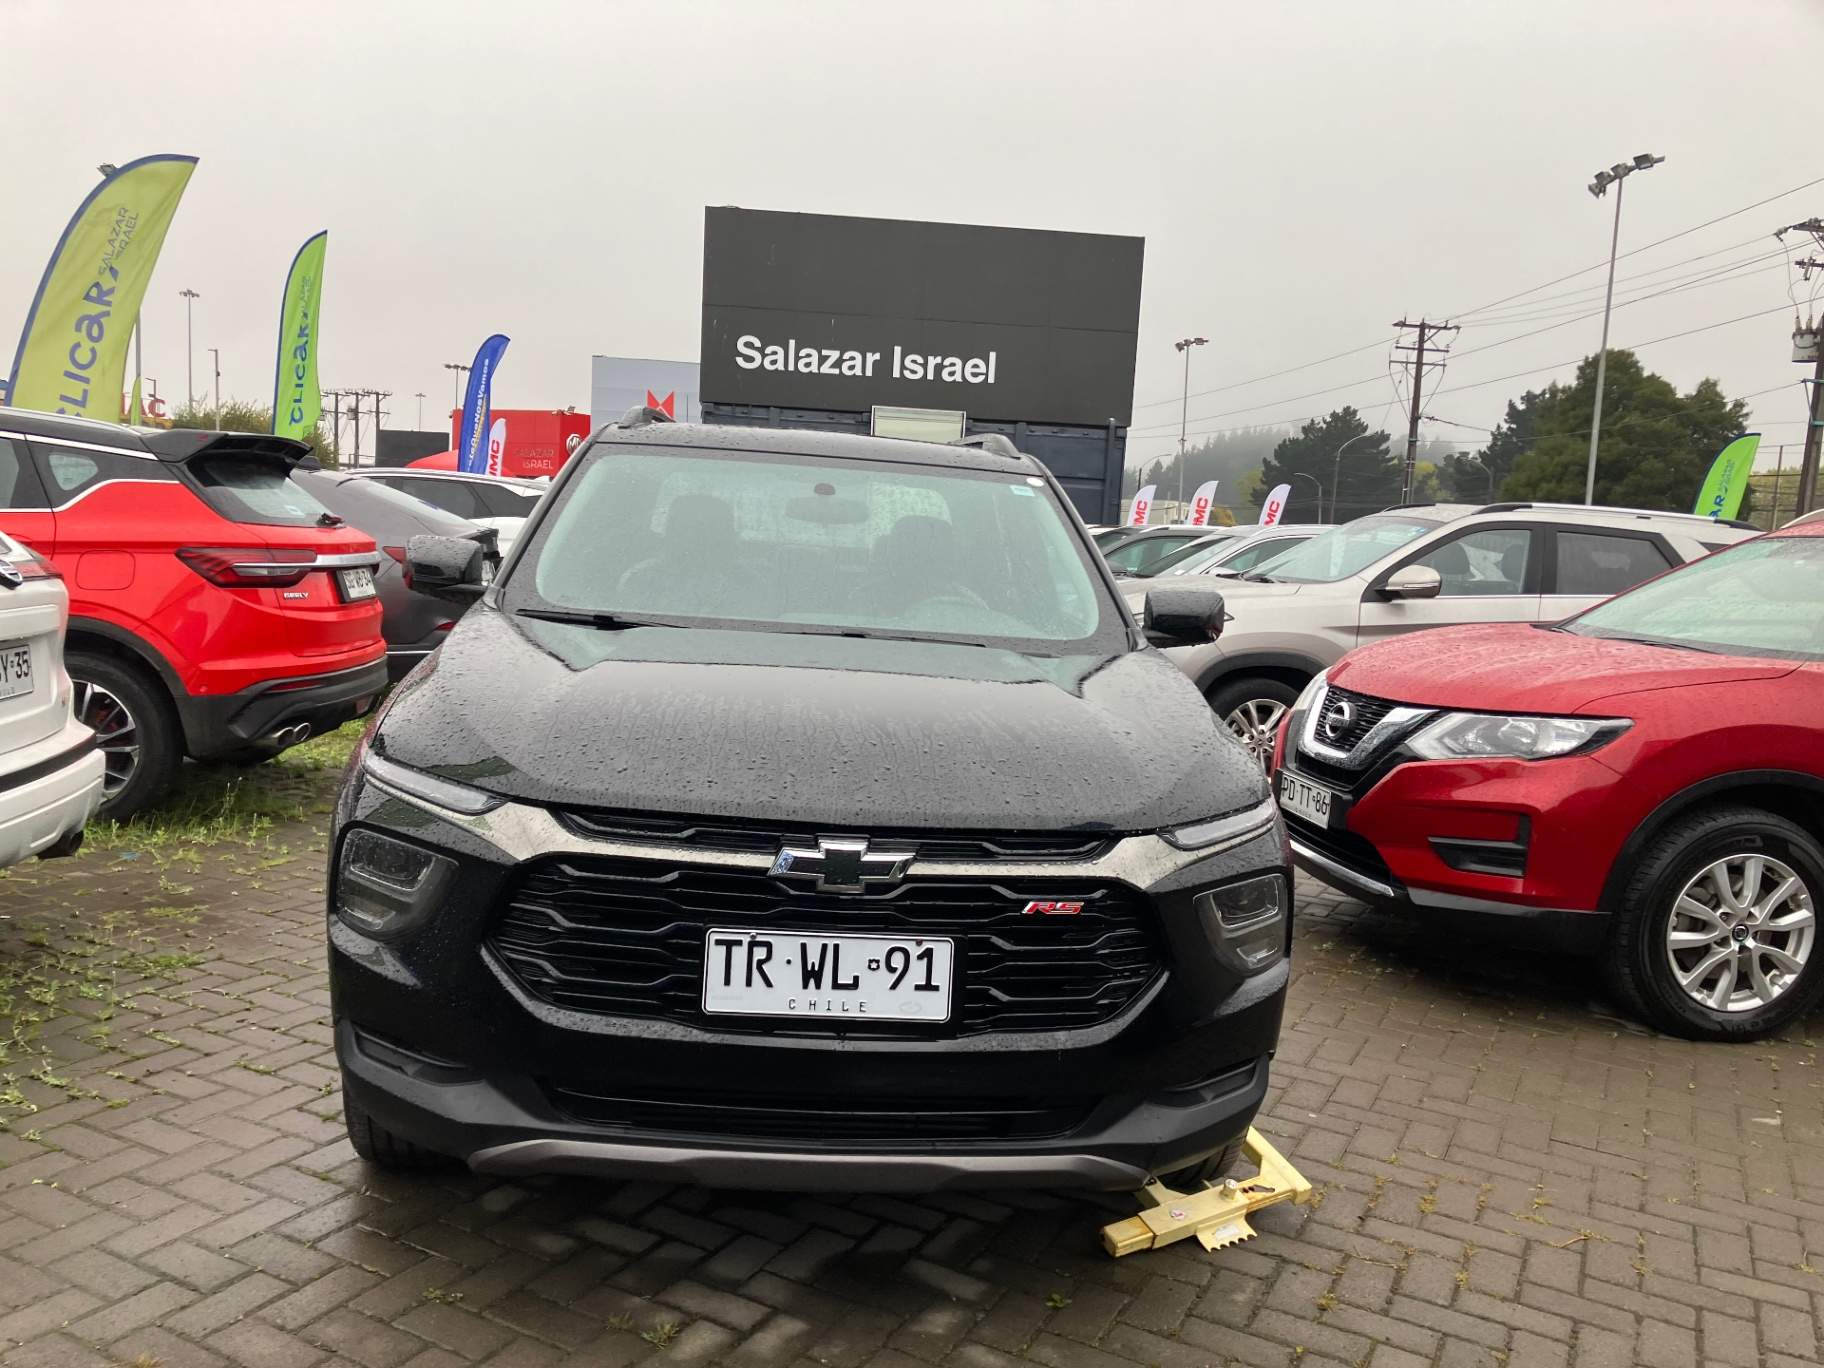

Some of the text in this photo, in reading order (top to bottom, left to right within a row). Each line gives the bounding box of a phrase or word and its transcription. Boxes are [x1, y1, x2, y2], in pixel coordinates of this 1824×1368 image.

[55, 280, 116, 417] LICaR
[734, 334, 997, 384] Salazar Israel
[522, 459, 554, 470] ISRAEL
[1021, 901, 1085, 915] RS
[788, 999, 868, 1013] CHILE
